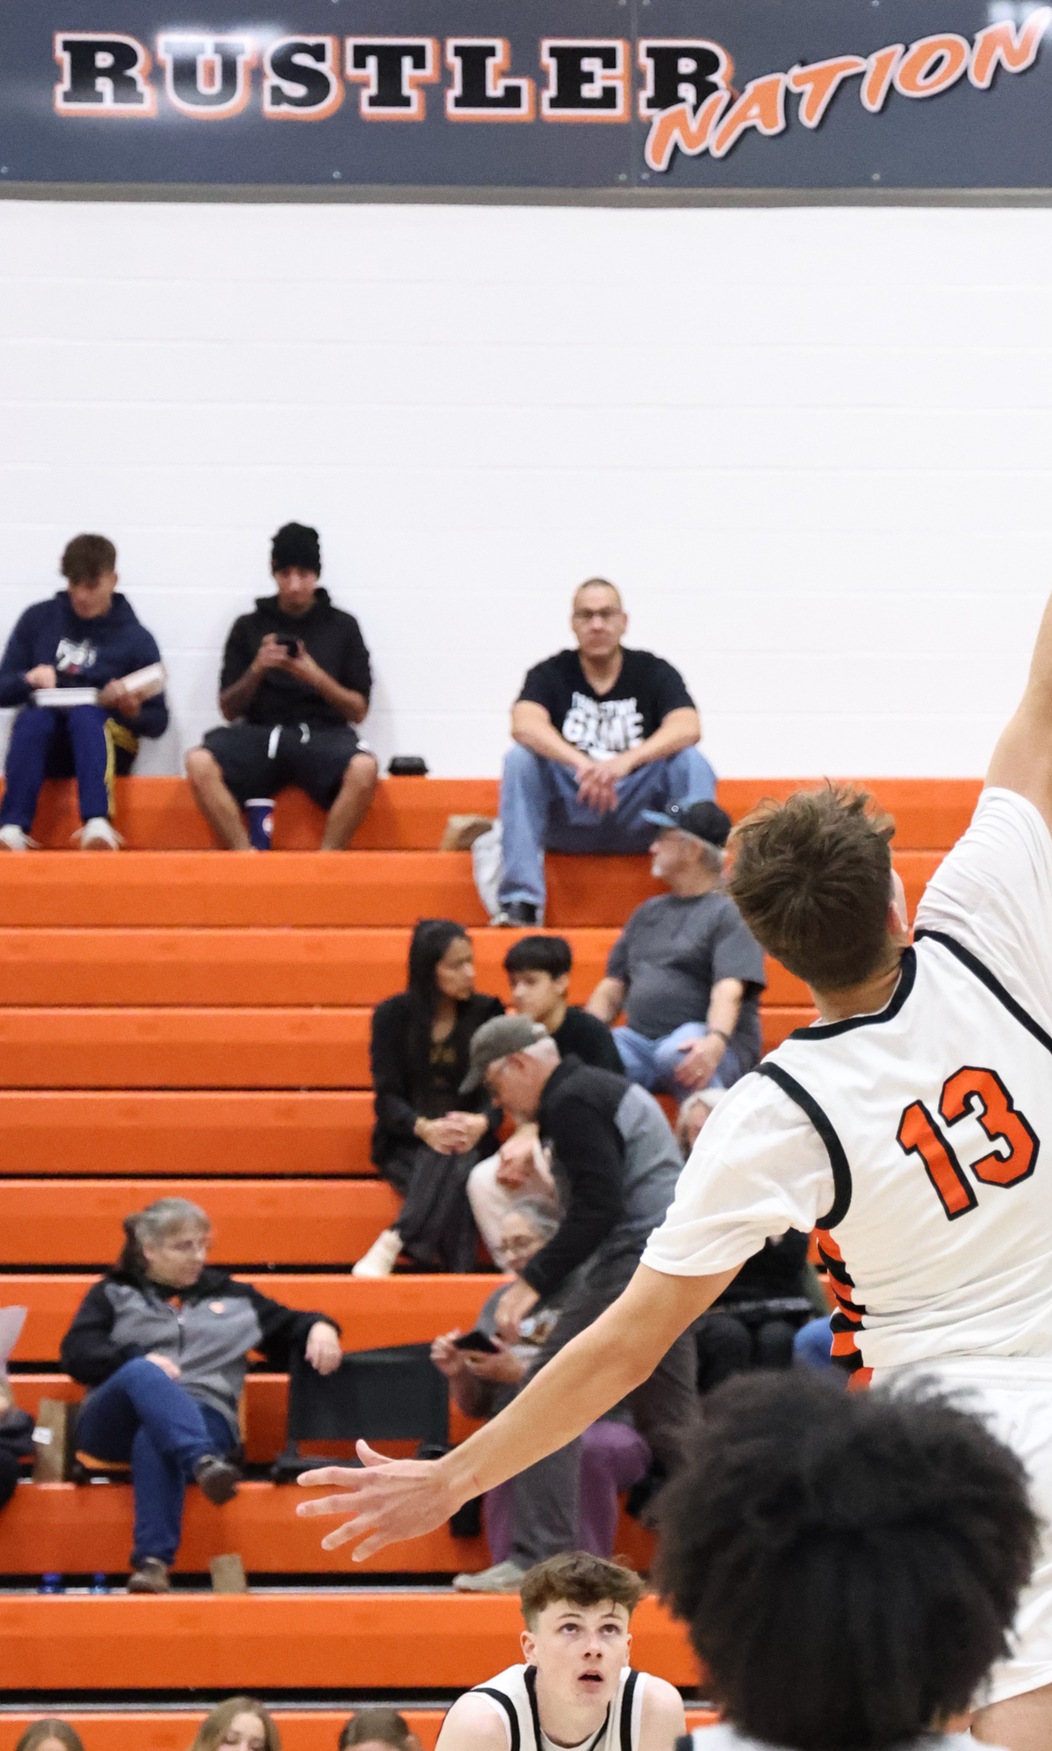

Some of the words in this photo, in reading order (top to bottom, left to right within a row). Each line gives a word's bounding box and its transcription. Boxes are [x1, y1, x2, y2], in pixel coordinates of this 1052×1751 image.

[54, 31, 733, 121] RUSTLER
[644, 6, 1052, 171] NATION
[896, 1065, 1041, 1222] 13
